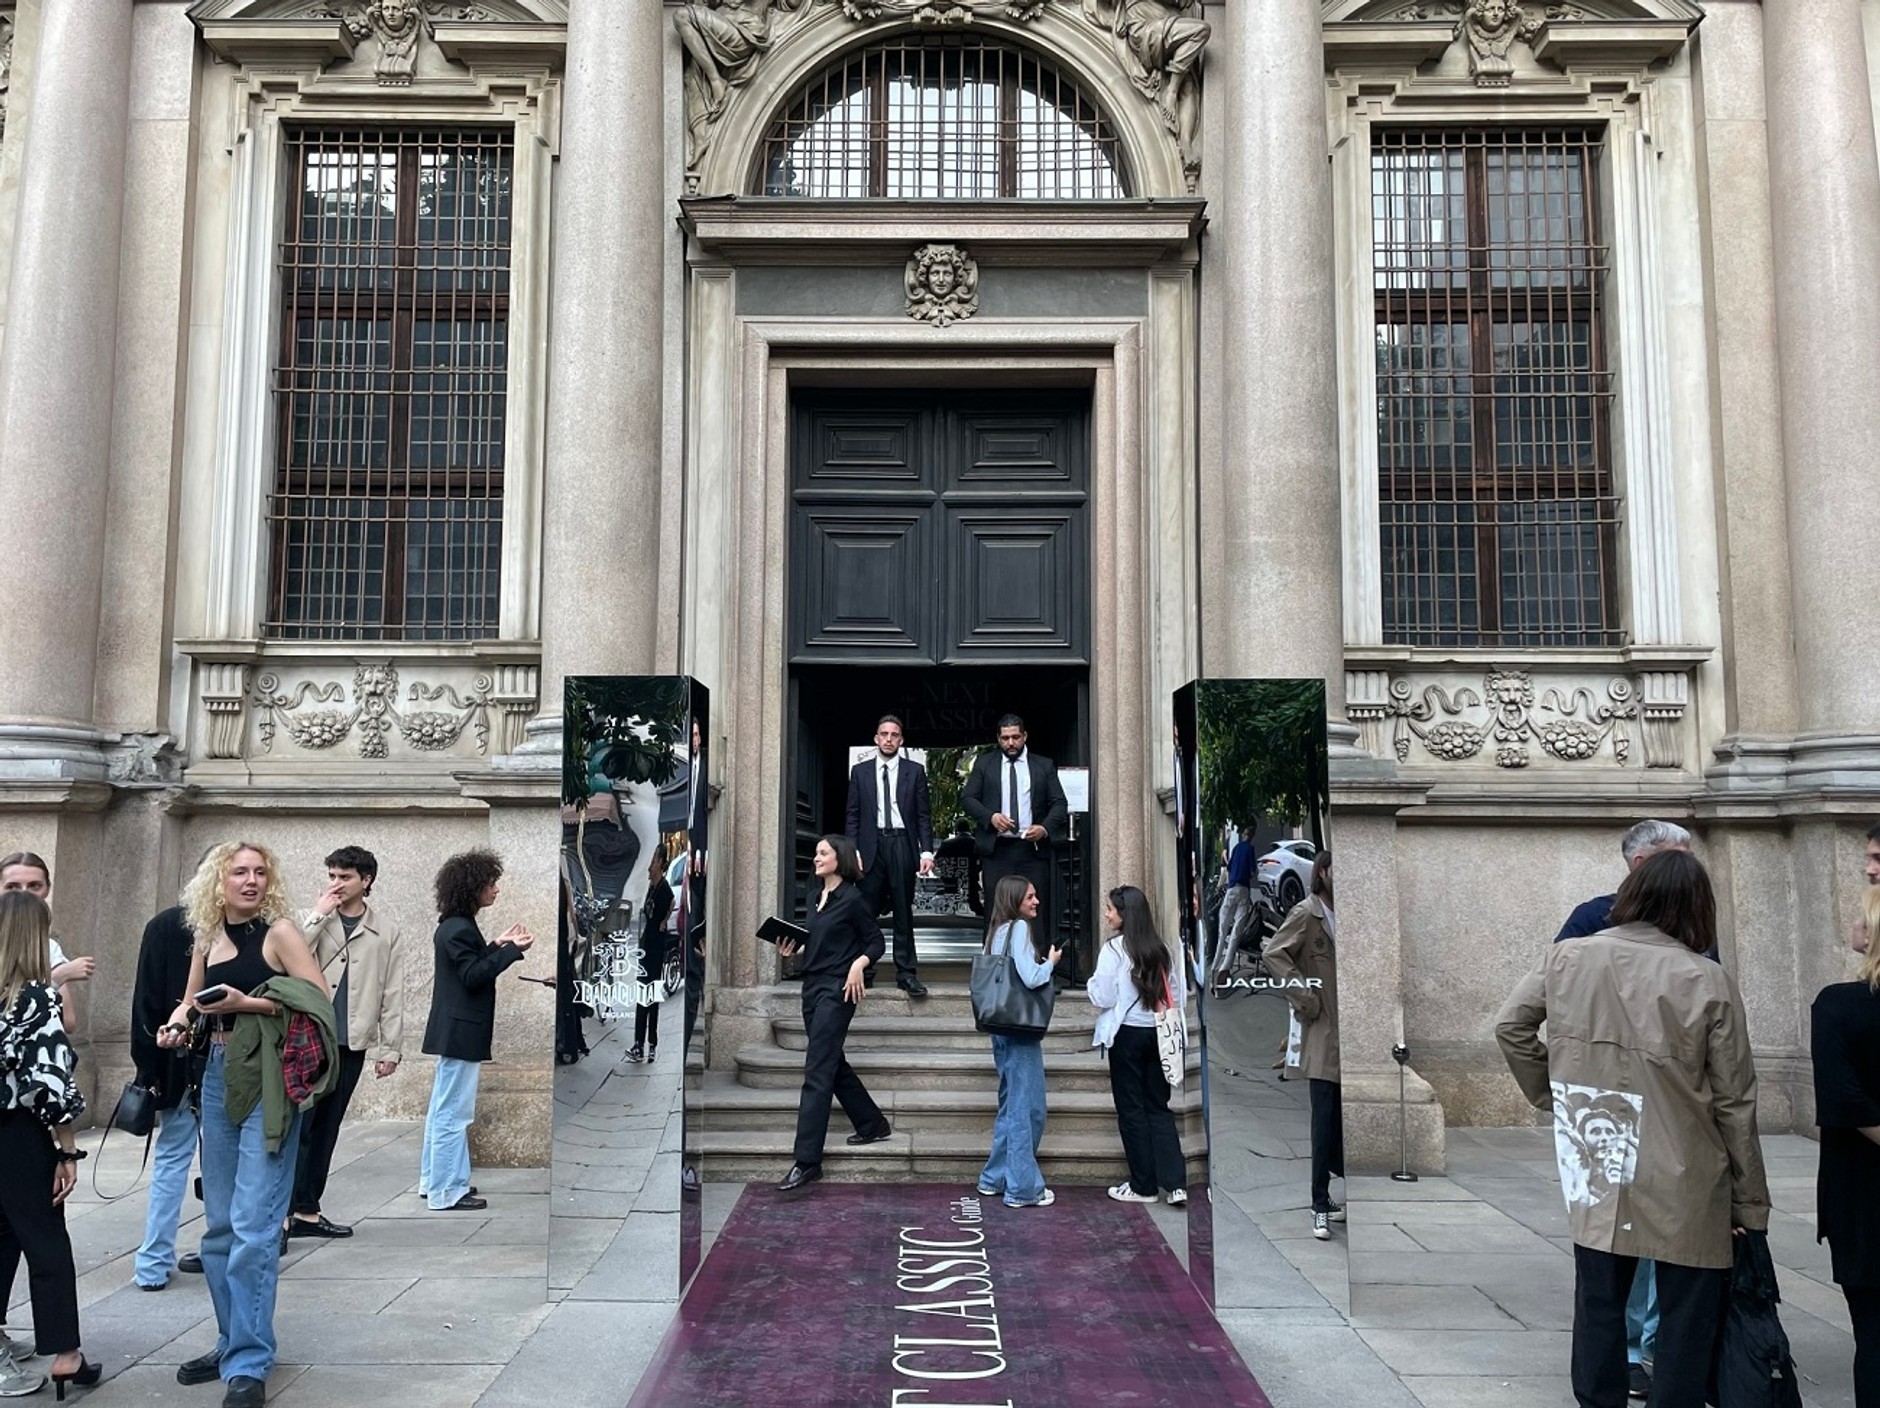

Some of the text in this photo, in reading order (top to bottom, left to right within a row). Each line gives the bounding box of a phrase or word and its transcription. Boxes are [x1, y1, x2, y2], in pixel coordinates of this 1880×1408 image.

[1216, 977, 1323, 989] JAGUAR
[583, 981, 655, 1003] BARACUTA
[601, 1011, 636, 1019] ENGLAND
[891, 1225, 1007, 1380] CLASSIC
[950, 1196, 983, 1223] Guide
